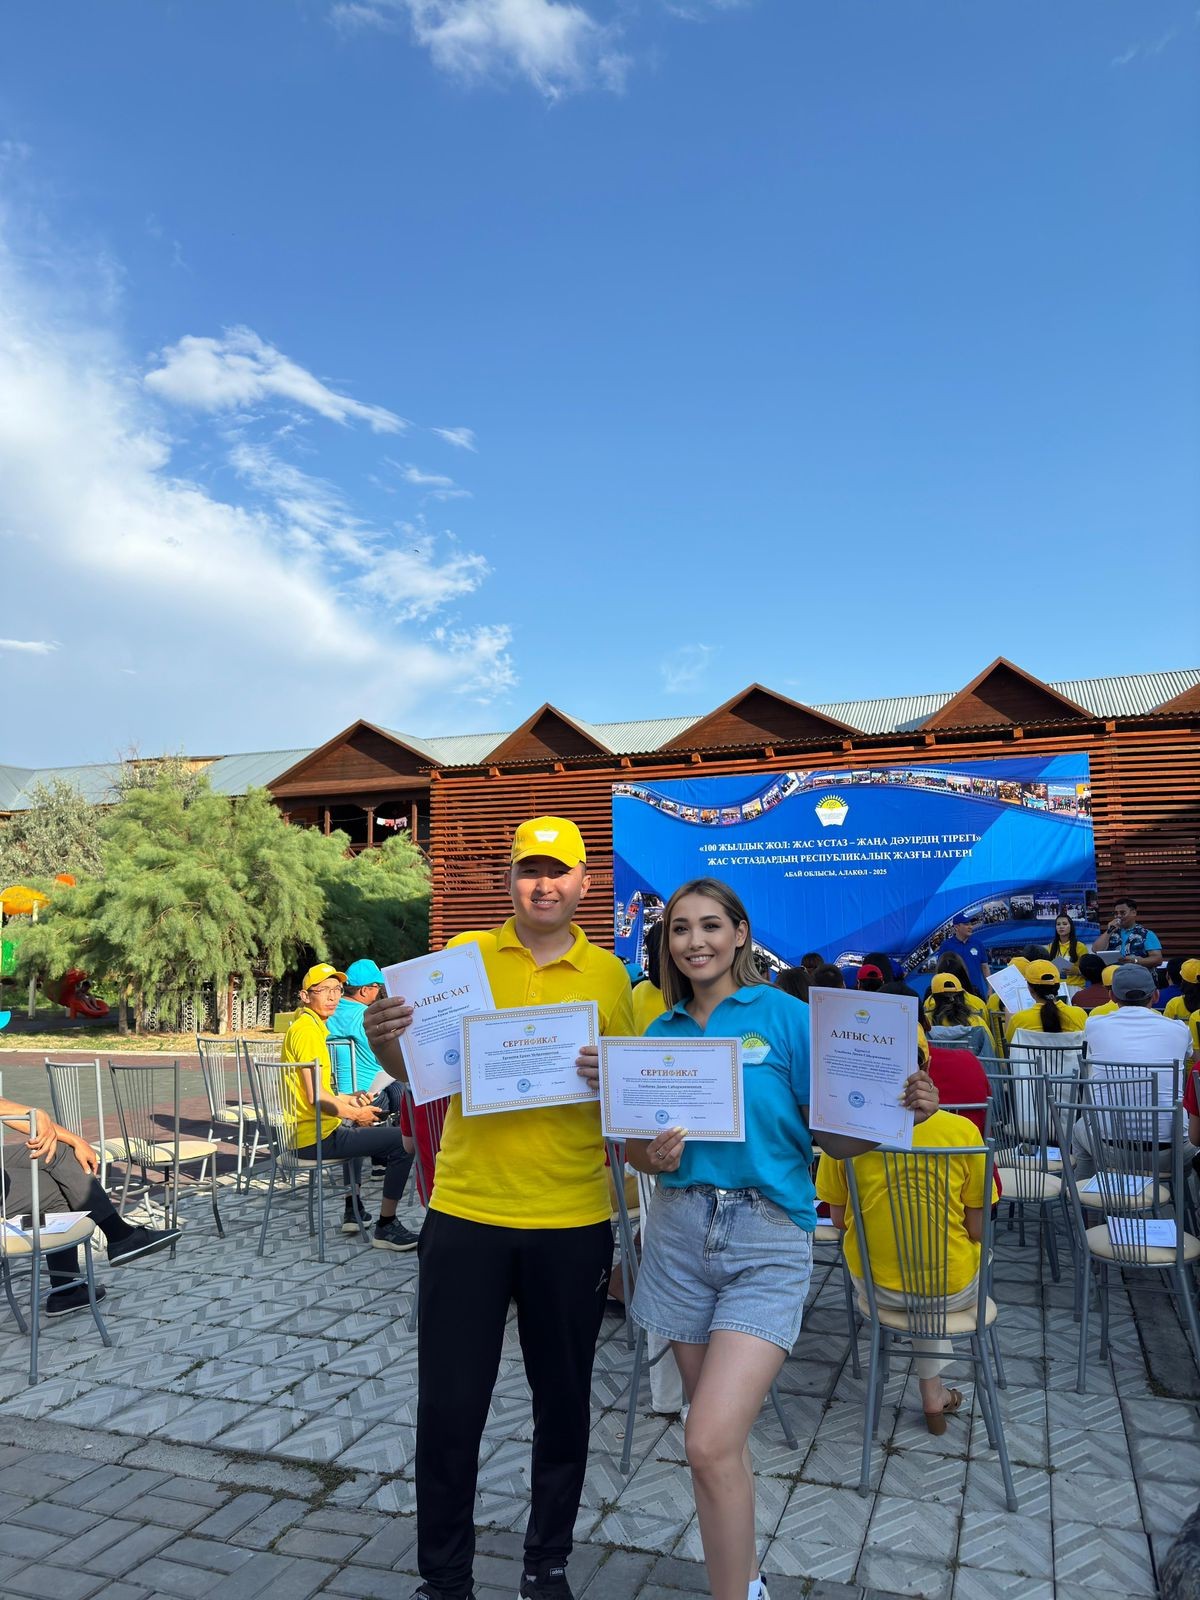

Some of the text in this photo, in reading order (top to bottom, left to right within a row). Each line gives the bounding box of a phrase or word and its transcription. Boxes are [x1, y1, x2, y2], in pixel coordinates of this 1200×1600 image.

[699, 843, 717, 852] «100
[718, 841, 764, 852] ЖЫЛДЫҚ
[765, 840, 791, 850] ЖОЛ:
[792, 839, 815, 849] ЖАС
[816, 838, 848, 848] ҰСТАЗ
[857, 837, 888, 847] ЖАҢА
[889, 835, 940, 846] ДӘУІРДІҢ
[941, 833, 982, 844] ТІРЕГІ»
[707, 848, 973, 866] ЖАС ҰСТАЗДАРДЫҢ РЕСПУБЛИКАЛЫҚ ЖАЗҒЫ ЛАГЕРІ
[784, 869, 802, 878] АБАЙ
[838, 869, 868, 877] АЛАКӨЛ
[872, 868, 888, 876] 2025
[413, 984, 470, 1009] АЛҒЫС ХАТ
[502, 1035, 558, 1048] СЕРТИФИКАТ
[830, 1029, 895, 1046] АЛҒЫС ХАТ
[640, 1069, 698, 1077] СЕРТИФИКАТ
